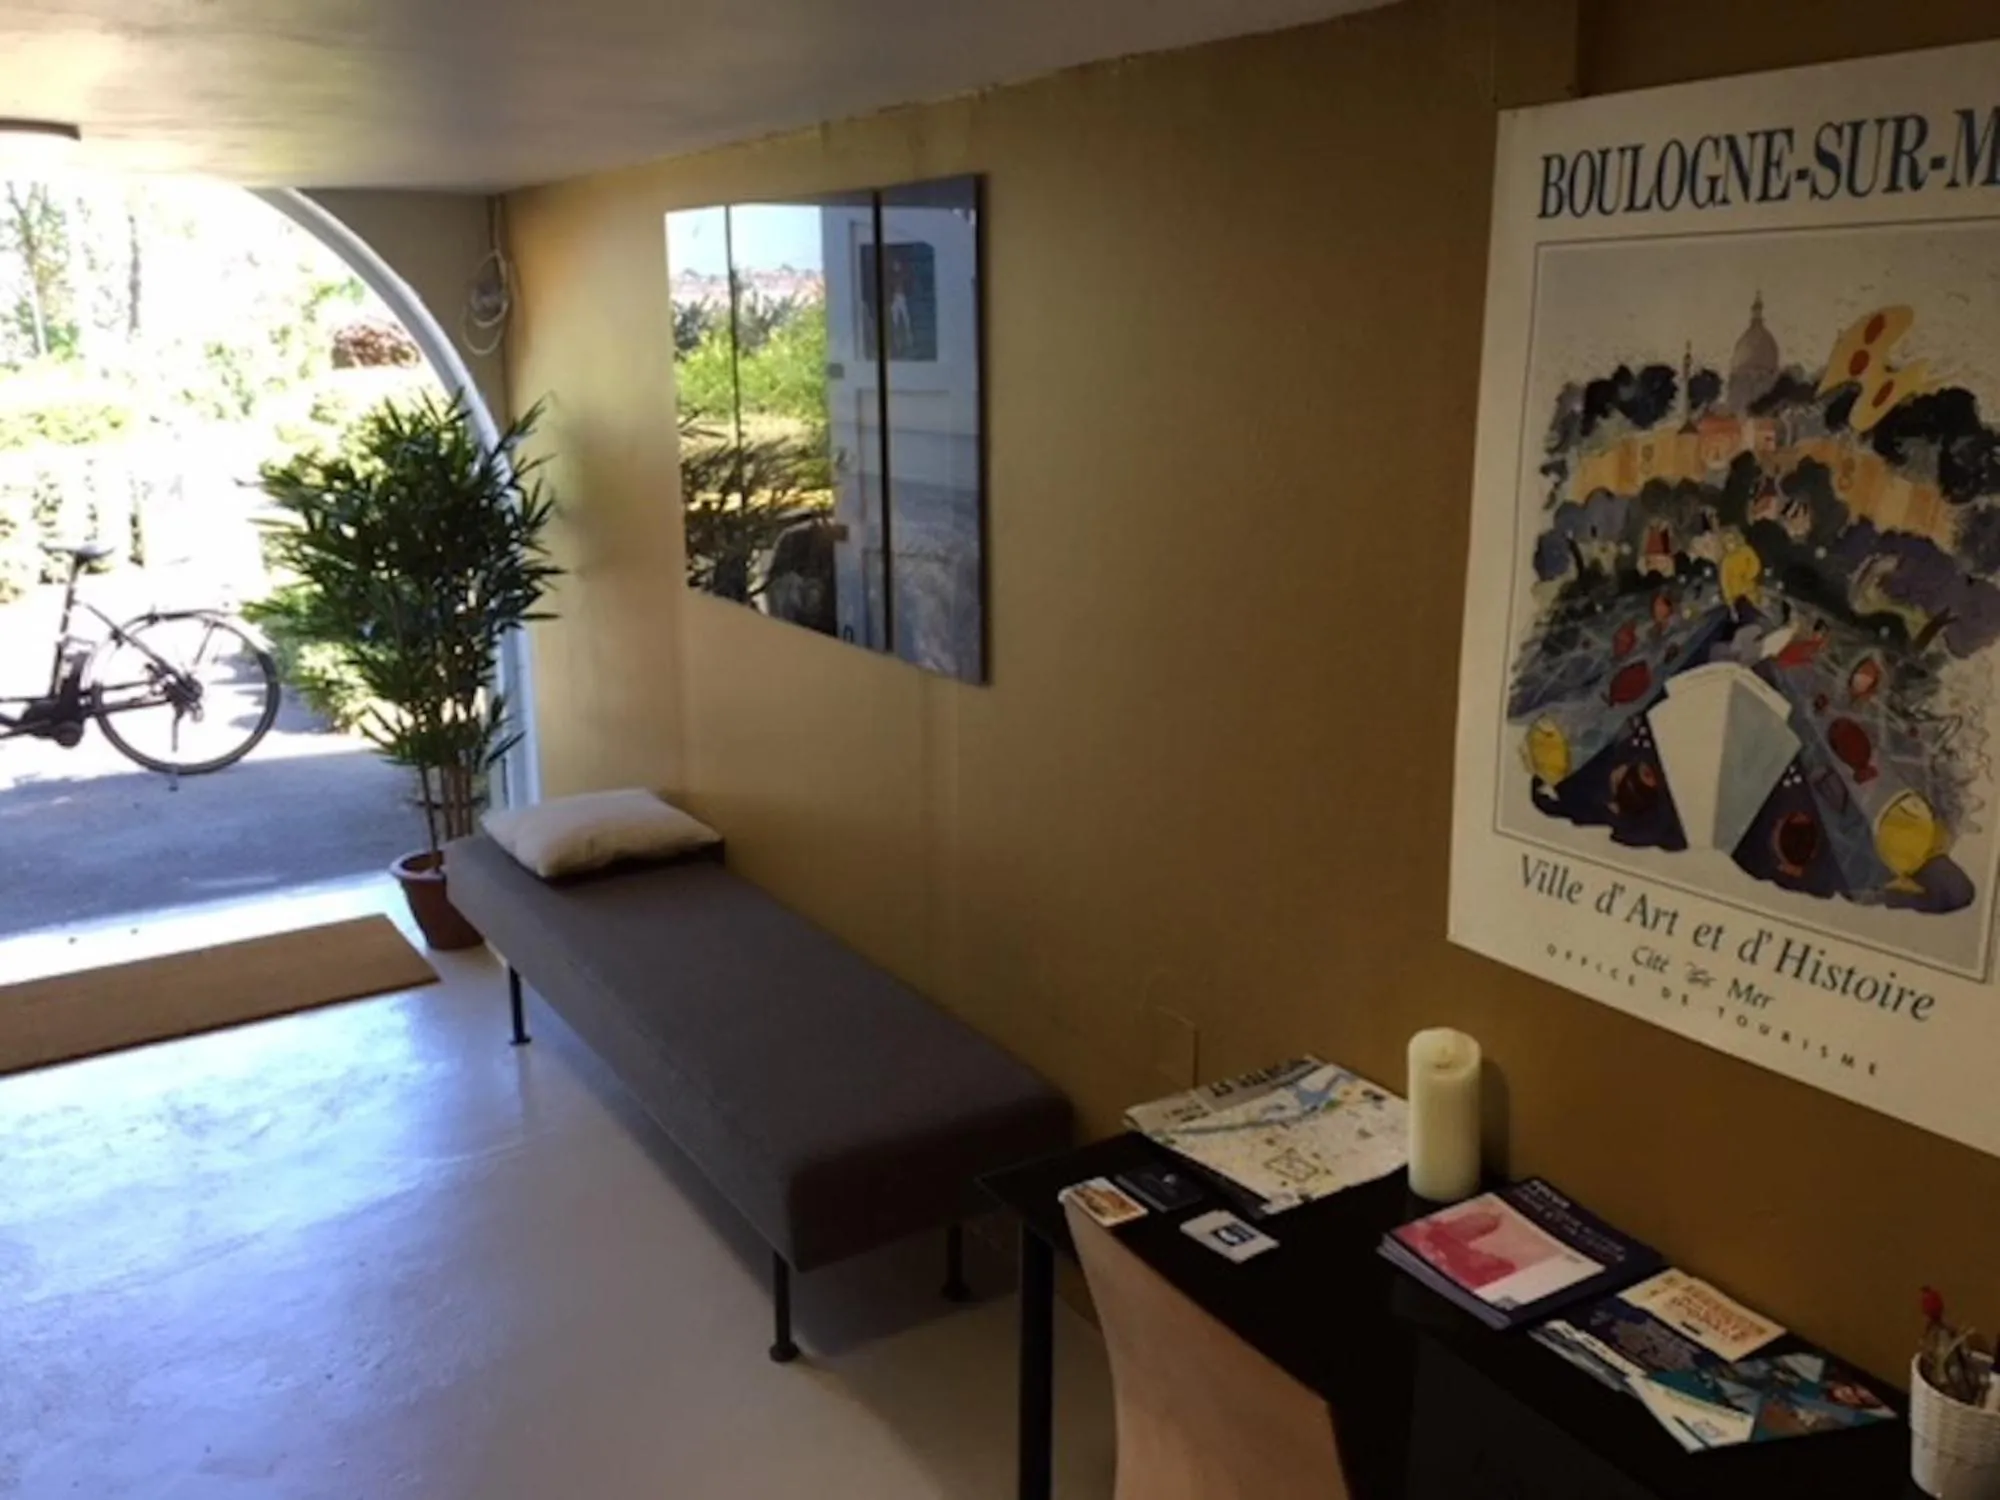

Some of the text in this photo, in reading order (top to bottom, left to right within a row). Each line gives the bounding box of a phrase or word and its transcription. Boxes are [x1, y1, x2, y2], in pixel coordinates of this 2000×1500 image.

[1520, 854, 1583, 905] Ville
[1692, 921, 1726, 952] et
[1546, 943, 1637, 988] OFFICE
[1660, 986, 1690, 1008] DE
[1717, 1006, 1880, 1077] TOURISME
[1727, 978, 1776, 1011] Mer
